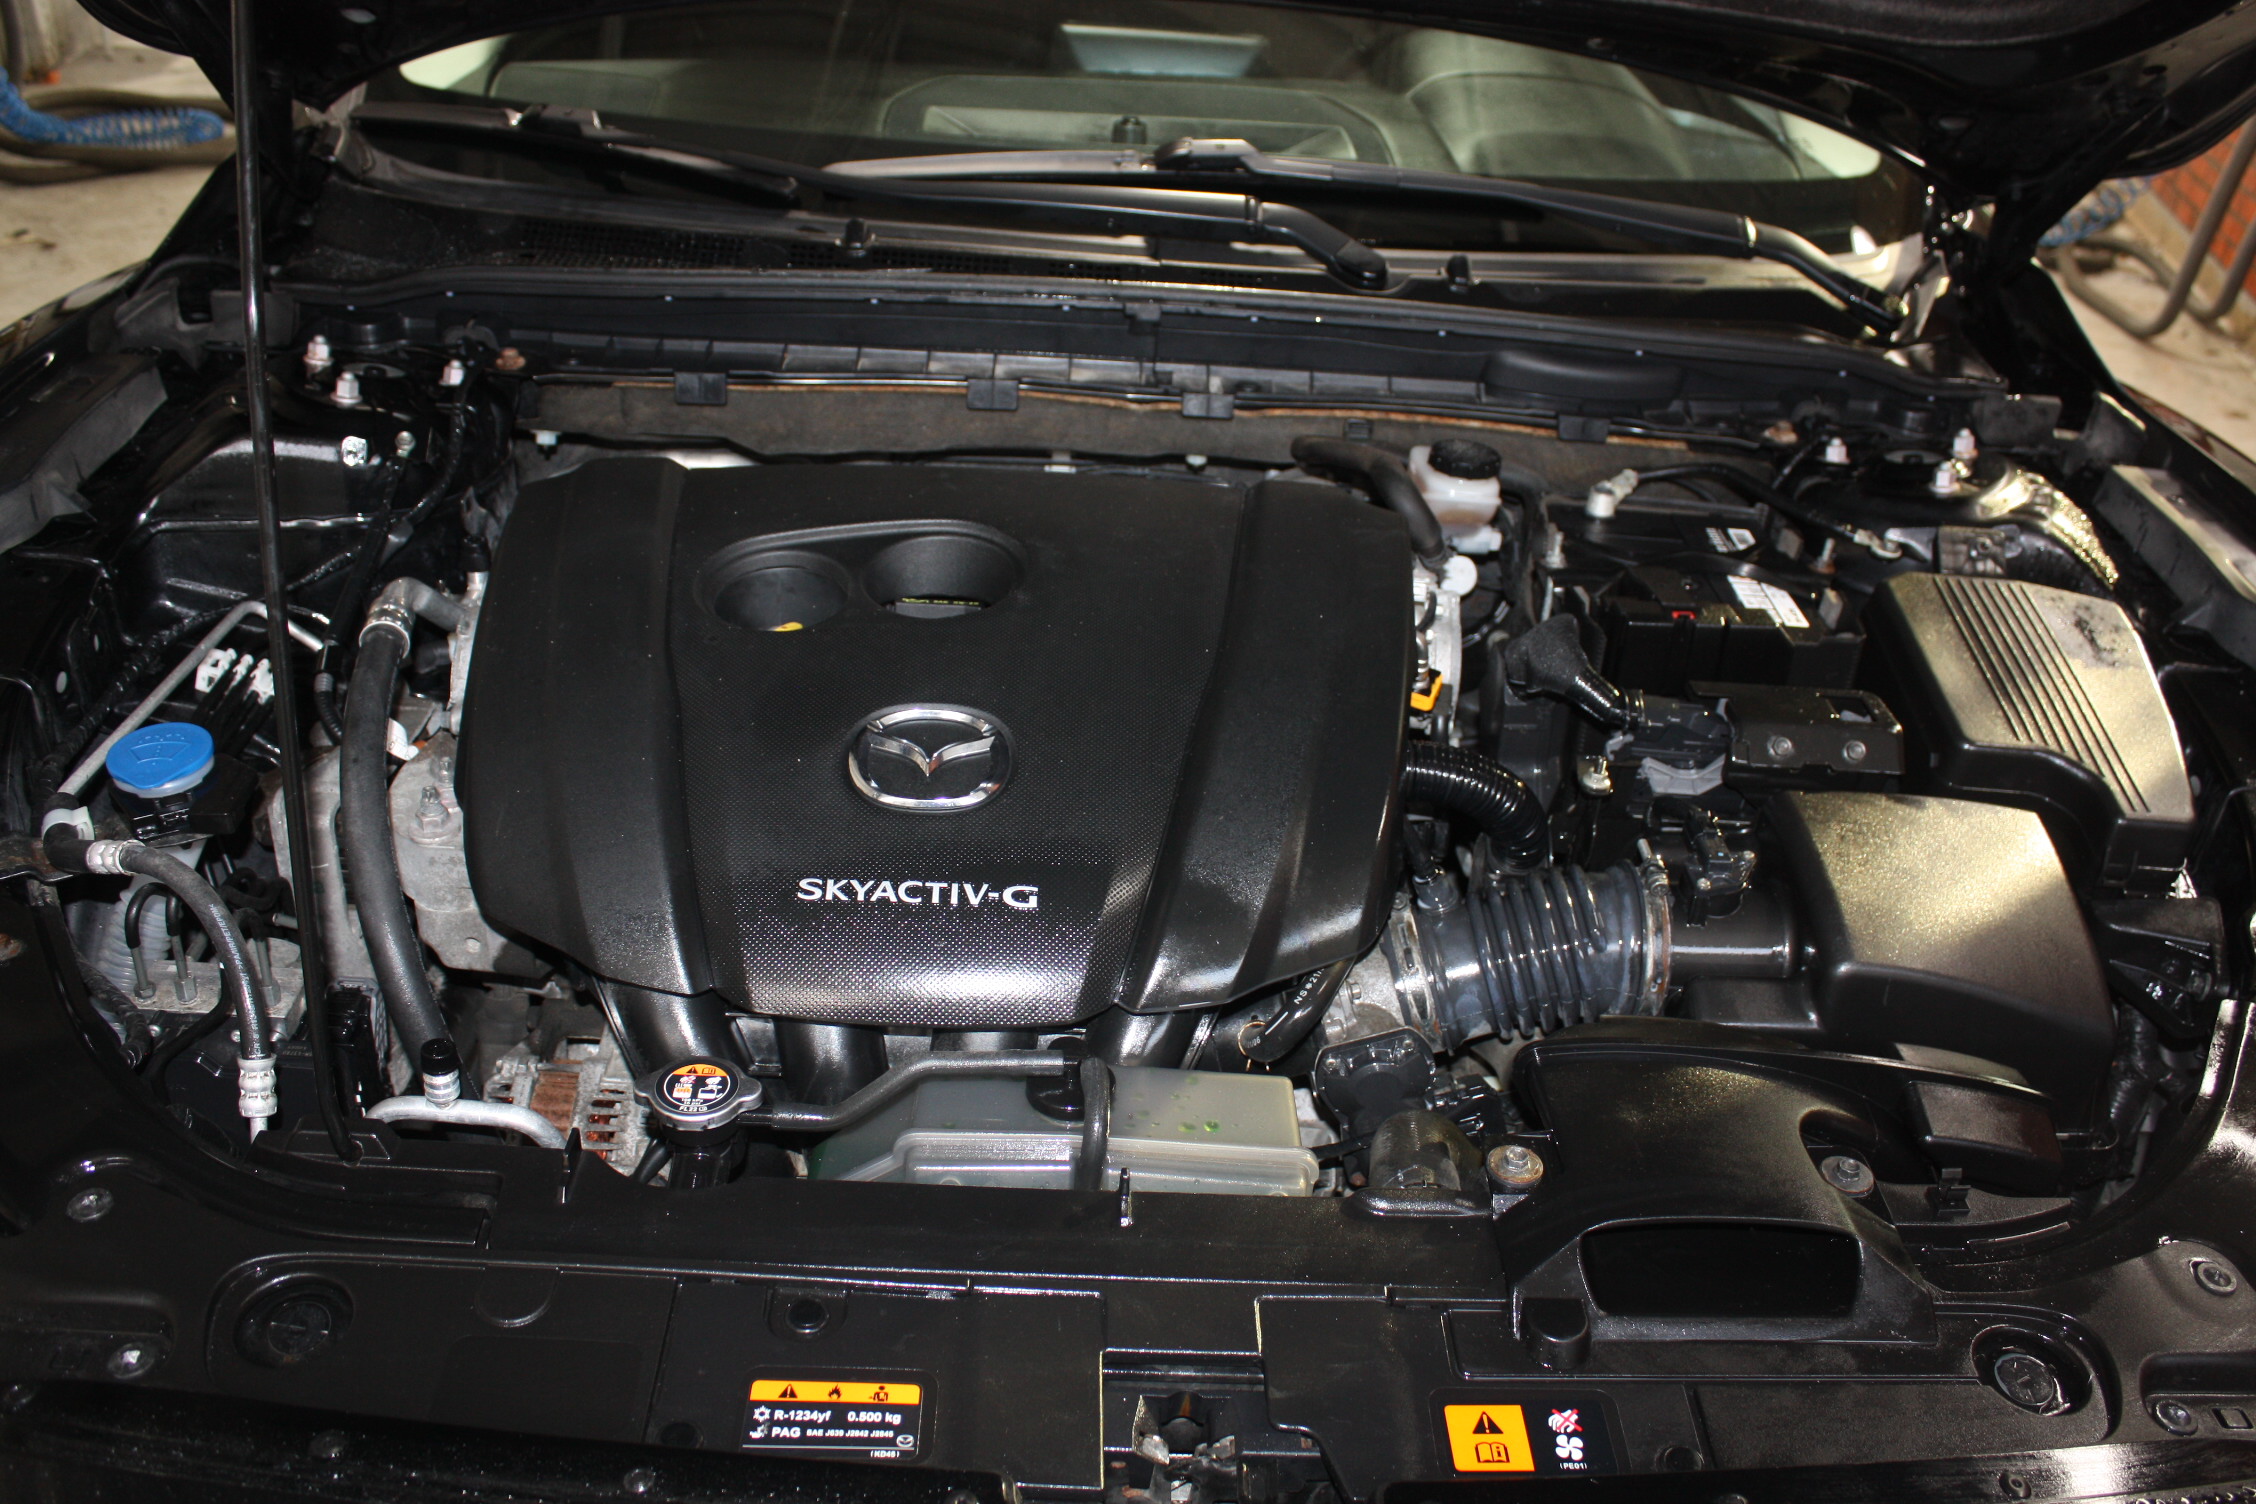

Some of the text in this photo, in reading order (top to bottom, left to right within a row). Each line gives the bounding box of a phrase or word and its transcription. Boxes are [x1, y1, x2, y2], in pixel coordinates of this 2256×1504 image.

[797, 877, 1039, 909] SKYACTIV-G
[773, 1409, 902, 1425] R-1234yf 0.500 kg
[771, 1426, 801, 1438] PAG
[806, 1428, 823, 1437] SAE
